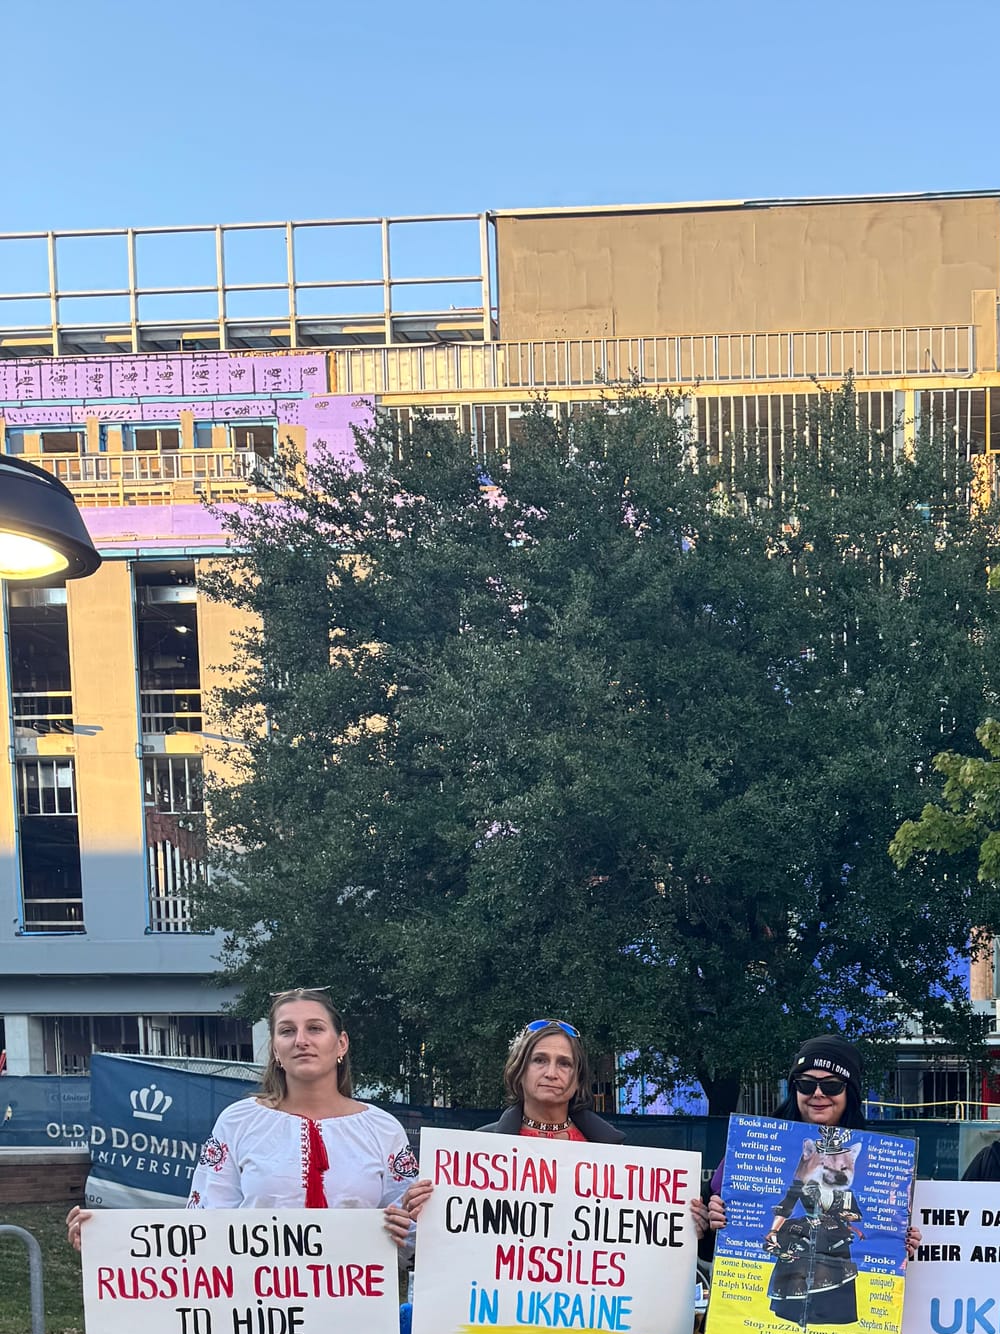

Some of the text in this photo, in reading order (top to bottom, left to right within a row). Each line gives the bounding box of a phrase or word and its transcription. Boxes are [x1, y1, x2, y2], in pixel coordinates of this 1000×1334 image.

[46, 1122, 85, 1138] OLD
[738, 1118, 788, 1130] Books and all
[746, 1130, 778, 1140] forms of
[111, 1127, 197, 1162] DOMIN
[741, 1141, 769, 1152] writing
[734, 1151, 755, 1160] terror
[766, 1154, 786, 1163] those
[91, 1149, 195, 1179] NIVERSIT
[736, 1162, 753, 1170] who
[754, 1164, 773, 1173] wish
[574, 1161, 688, 1205] CULTURE
[764, 1175, 785, 1185] truth.
[752, 1183, 781, 1194] Soyinka
[446, 1196, 553, 1238] CANNOT
[920, 1208, 969, 1226] THEY
[130, 1224, 206, 1258] STOP
[725, 1238, 763, 1249] Some books
[743, 1249, 757, 1258] free
[758, 1251, 770, 1259] and
[863, 1254, 896, 1265] Books
[741, 1260, 762, 1269] books
[254, 1264, 385, 1298] CULTURE
[716, 1269, 736, 1278] make
[747, 1272, 763, 1281] free.
[718, 1279, 764, 1292] Ralph Waldo
[721, 1291, 752, 1302] Emerson
[743, 1319, 765, 1330] Stop
